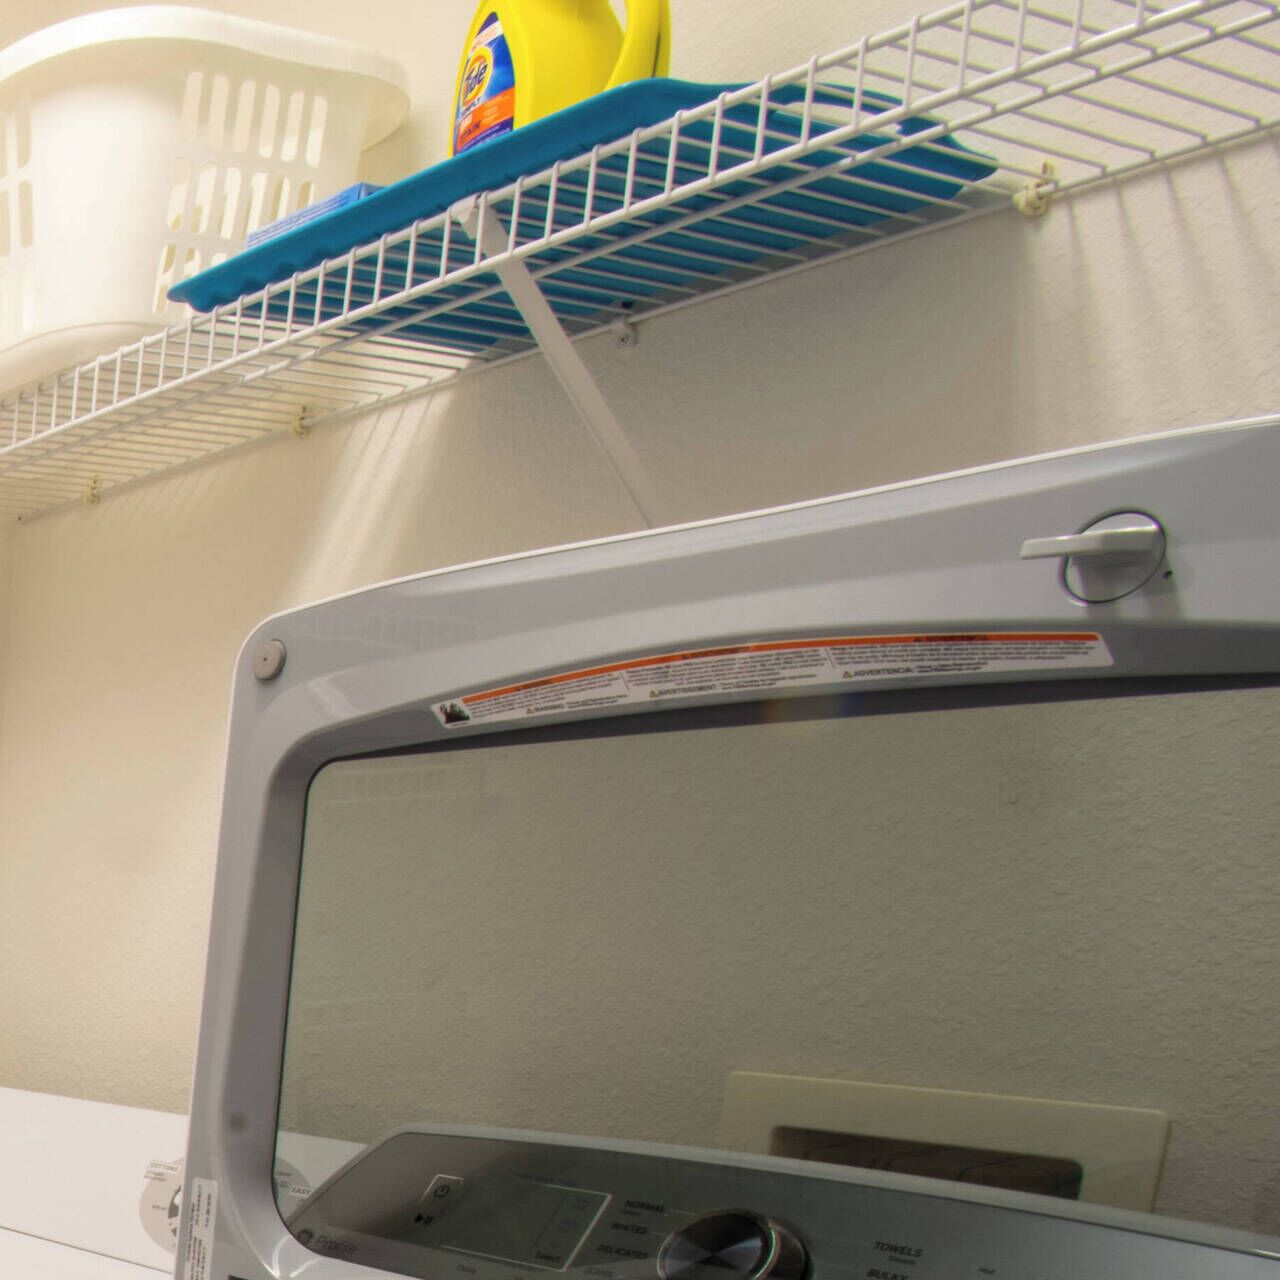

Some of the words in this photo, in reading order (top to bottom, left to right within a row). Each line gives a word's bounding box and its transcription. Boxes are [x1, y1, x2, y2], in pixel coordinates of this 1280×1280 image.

[462, 63, 488, 99] Tide
[624, 1200, 665, 1213] NORMAL
[611, 1222, 648, 1235] WHITES
[597, 1244, 649, 1260] DELICATES
[874, 1241, 923, 1258] TOWELS
